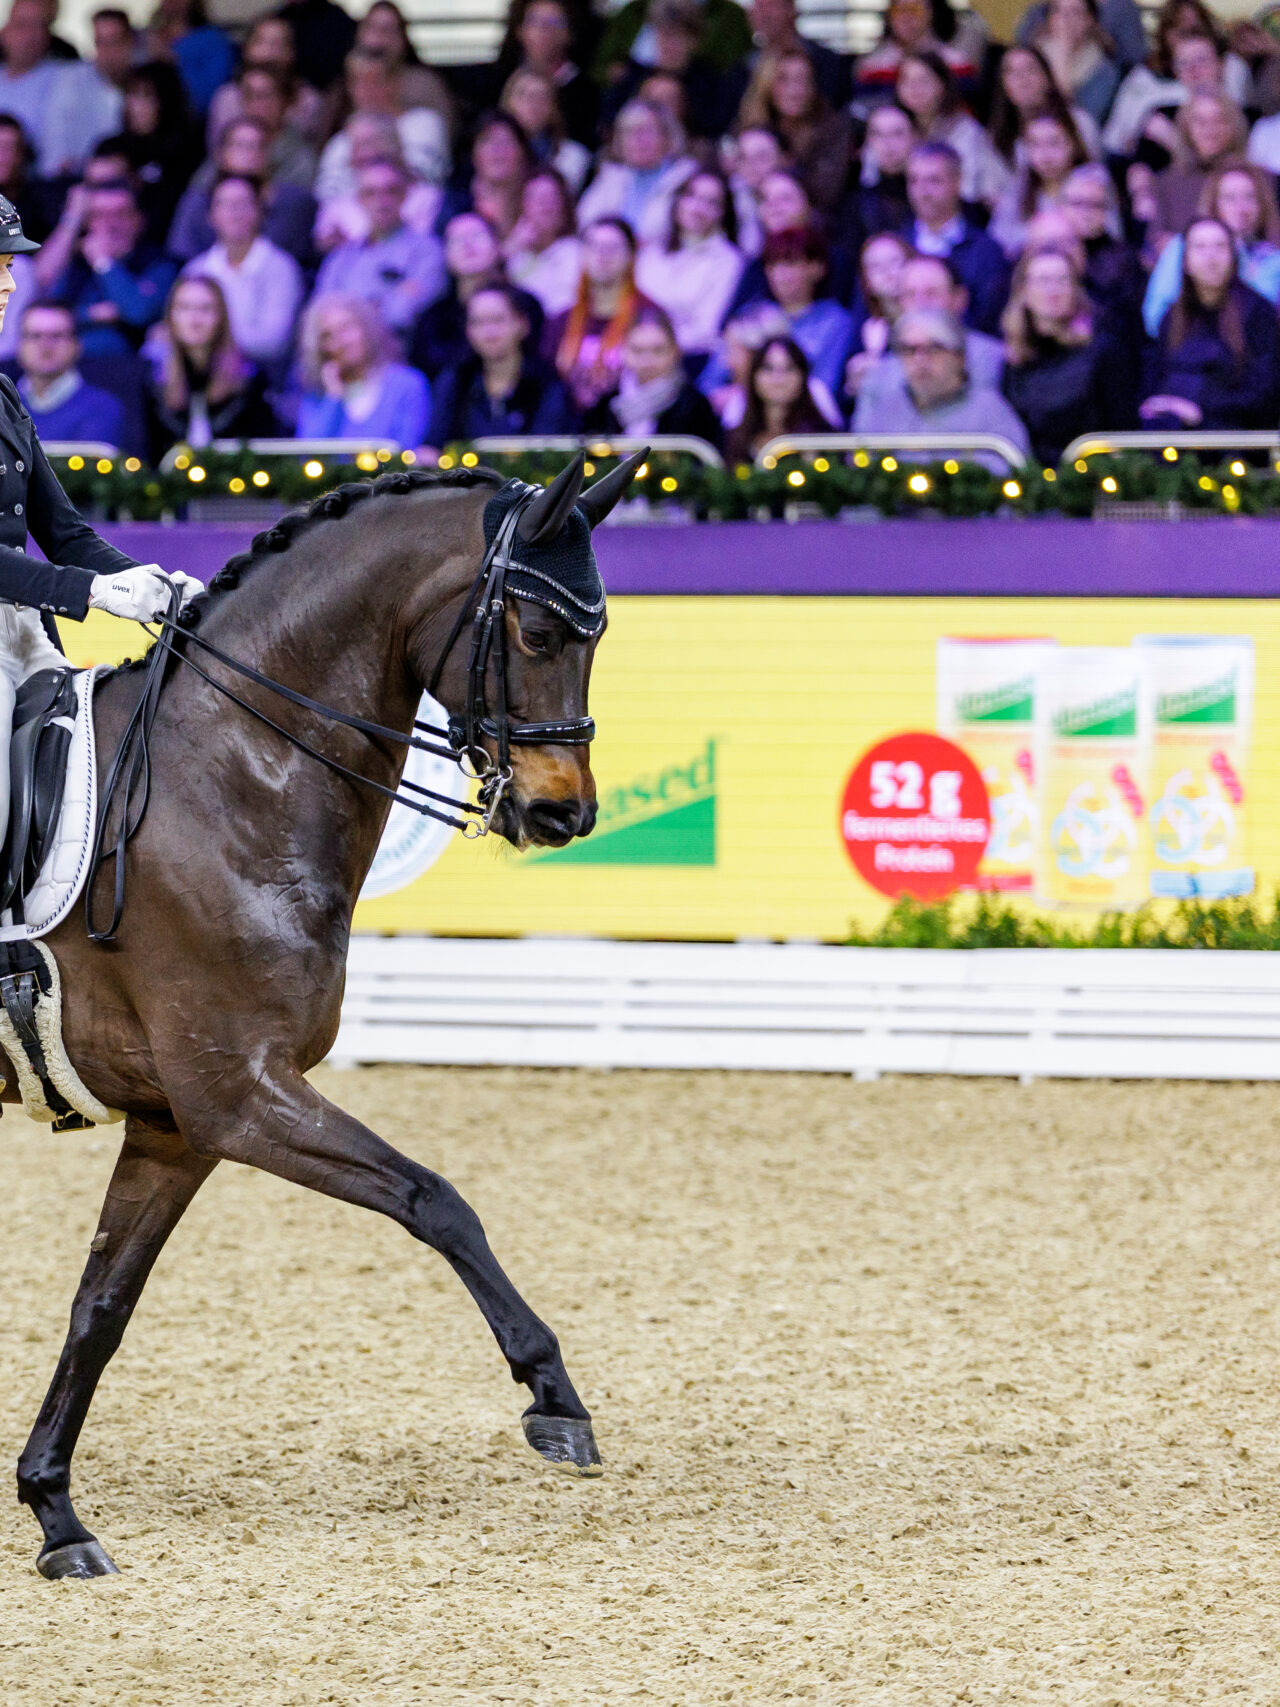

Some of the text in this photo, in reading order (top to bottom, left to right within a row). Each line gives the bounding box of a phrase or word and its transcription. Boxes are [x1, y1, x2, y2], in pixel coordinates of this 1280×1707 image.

[111, 584, 130, 593] uvex
[870, 760, 963, 821] 52 g
